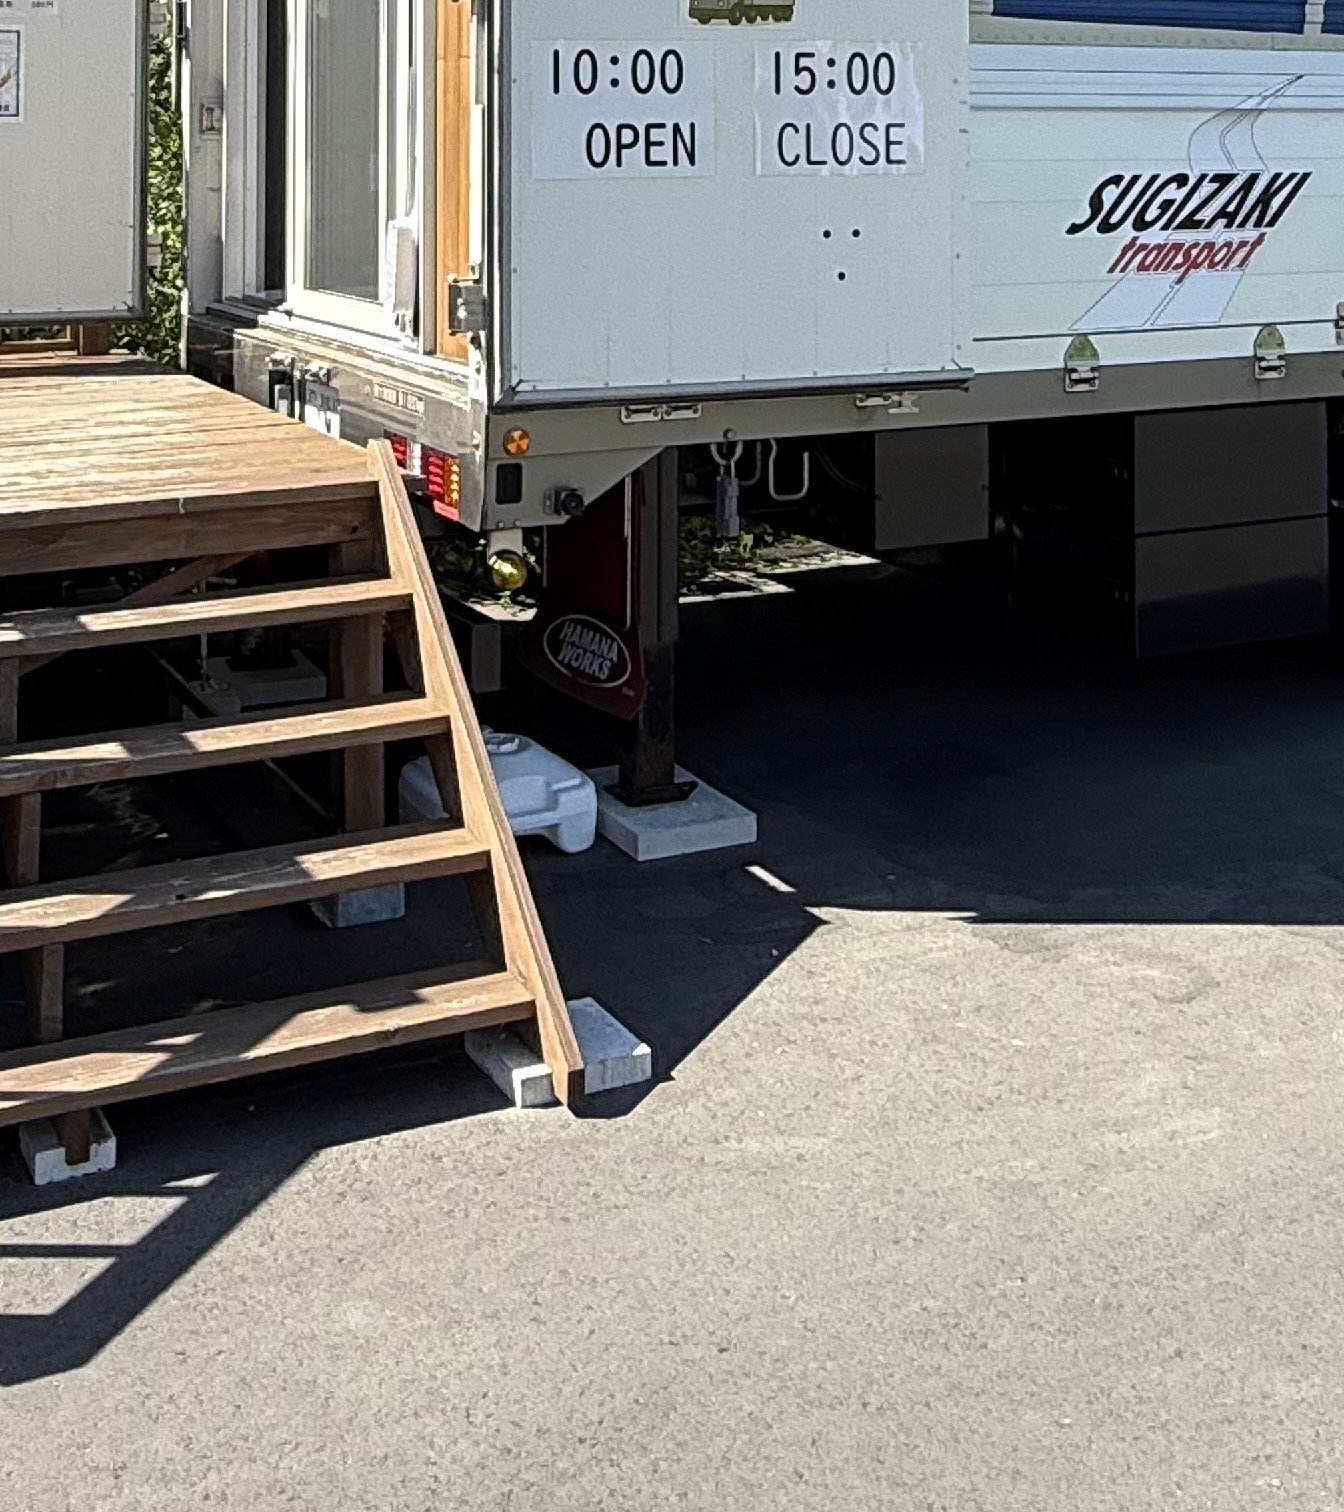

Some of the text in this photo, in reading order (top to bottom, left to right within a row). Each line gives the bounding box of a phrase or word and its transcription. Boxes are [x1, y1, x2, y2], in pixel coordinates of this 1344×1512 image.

[551, 47, 685, 96] 10:00
[772, 50, 897, 97] 15:00
[585, 121, 697, 169] OPEN
[776, 121, 908, 167] CLOSE
[1065, 170, 1313, 236] SUGIZAKI
[1106, 231, 1267, 286] transport
[557, 642, 612, 681] WORKS
[559, 620, 618, 664] HAMANA
